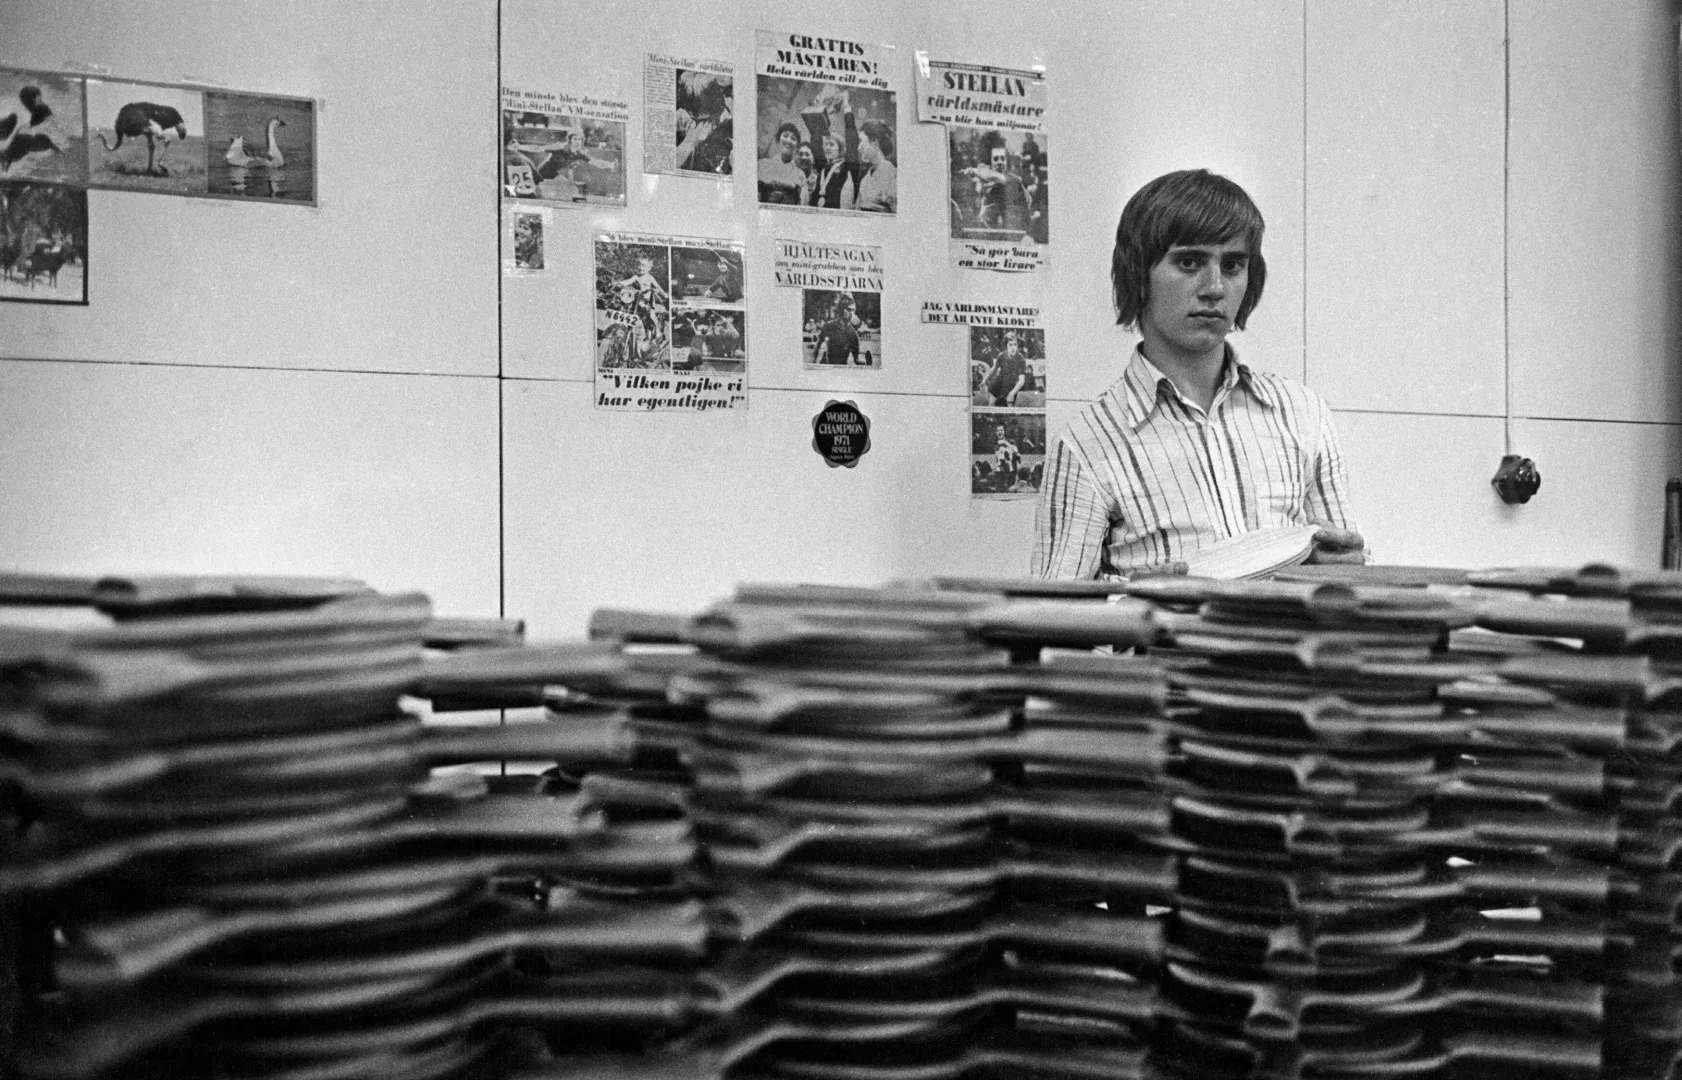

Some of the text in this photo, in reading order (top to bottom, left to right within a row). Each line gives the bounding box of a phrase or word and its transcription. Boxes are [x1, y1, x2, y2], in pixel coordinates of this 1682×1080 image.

[789, 34, 864, 56] GRATTIS
[777, 49, 878, 75] MÄSTAREN!
[766, 64, 888, 89] Hela världen vill se dig
[943, 71, 1025, 97] STELLAN
[502, 86, 521, 98] Den
[524, 90, 556, 101] minste
[559, 93, 578, 103] blev
[582, 95, 599, 106] den
[567, 105, 629, 121] VM-sensation
[927, 94, 1044, 118] världsmästare
[940, 115, 952, 123] nu
[955, 114, 973, 124] blir
[975, 116, 994, 126] han
[512, 171, 532, 189] 25
[784, 242, 875, 262] HJÄLTESAGAN
[791, 261, 847, 272] mini-grabben
[958, 259, 974, 267] en
[977, 259, 1000, 269] stor
[775, 268, 884, 290] VÄRLDSSTJÄRNA
[922, 301, 942, 312] JAG
[928, 313, 949, 323] DET
[970, 315, 994, 325] INTE
[997, 316, 1035, 327] KLOKT!
[675, 377, 722, 394] pojke
[727, 378, 743, 392] vi
[598, 392, 632, 406] har
[825, 411, 857, 423] WORLD
[818, 423, 863, 434] CHAMPION
[834, 434, 850, 446] 1971
